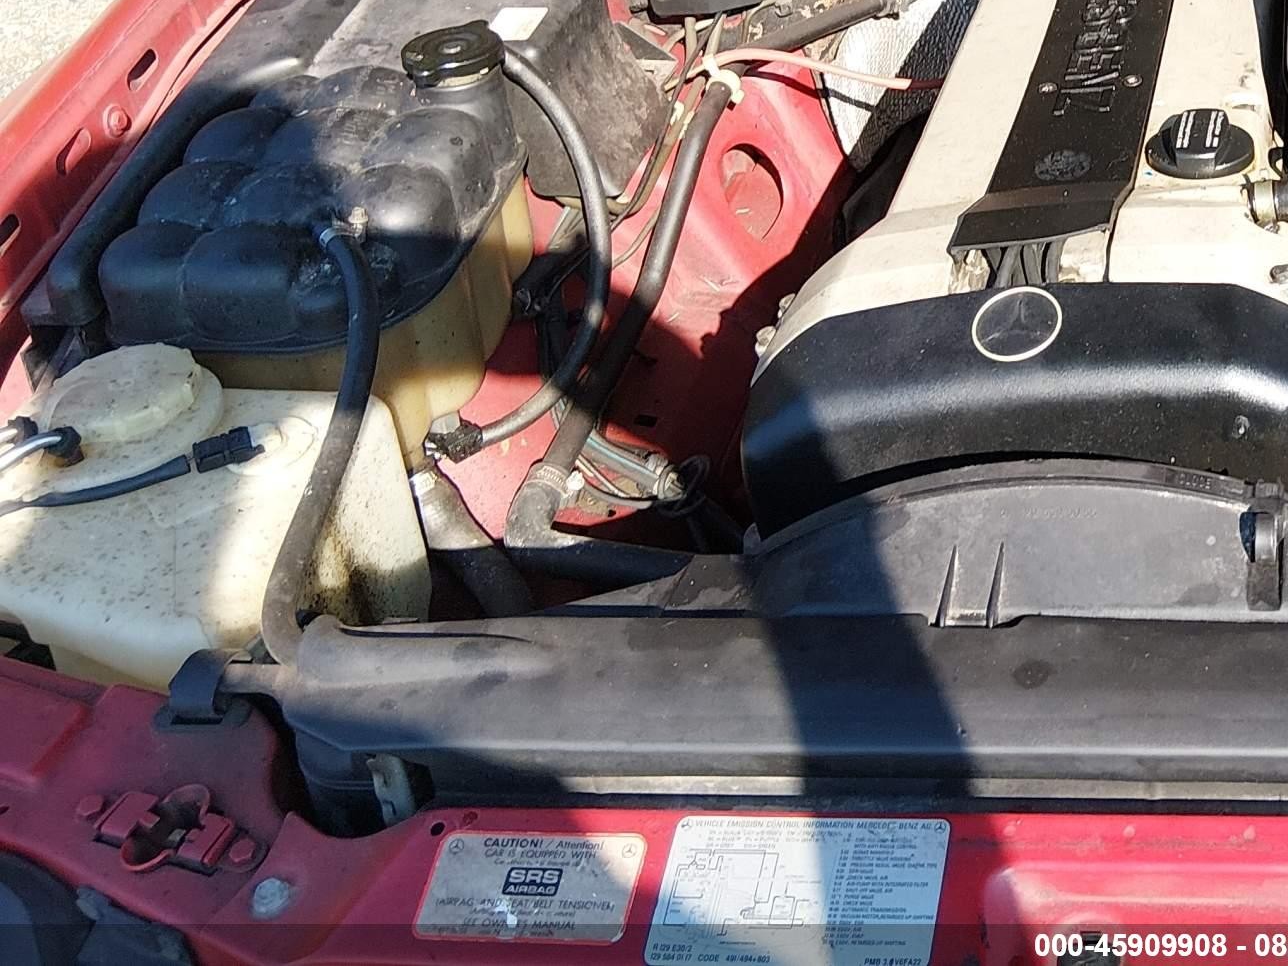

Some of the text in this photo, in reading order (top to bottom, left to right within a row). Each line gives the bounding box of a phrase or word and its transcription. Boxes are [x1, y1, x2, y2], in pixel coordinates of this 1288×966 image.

[727, 820, 764, 828] EMISSION
[766, 820, 800, 828] CONTROL
[803, 820, 854, 829] INFORMATION
[484, 838, 543, 848] CAUTION!
[556, 840, 604, 851] Attention!
[485, 849, 597, 859] CAR IS EQUIPPED WITH
[510, 870, 559, 883] SRS
[504, 885, 556, 895] AIRBAG
[532, 920, 576, 930] MANUAL
